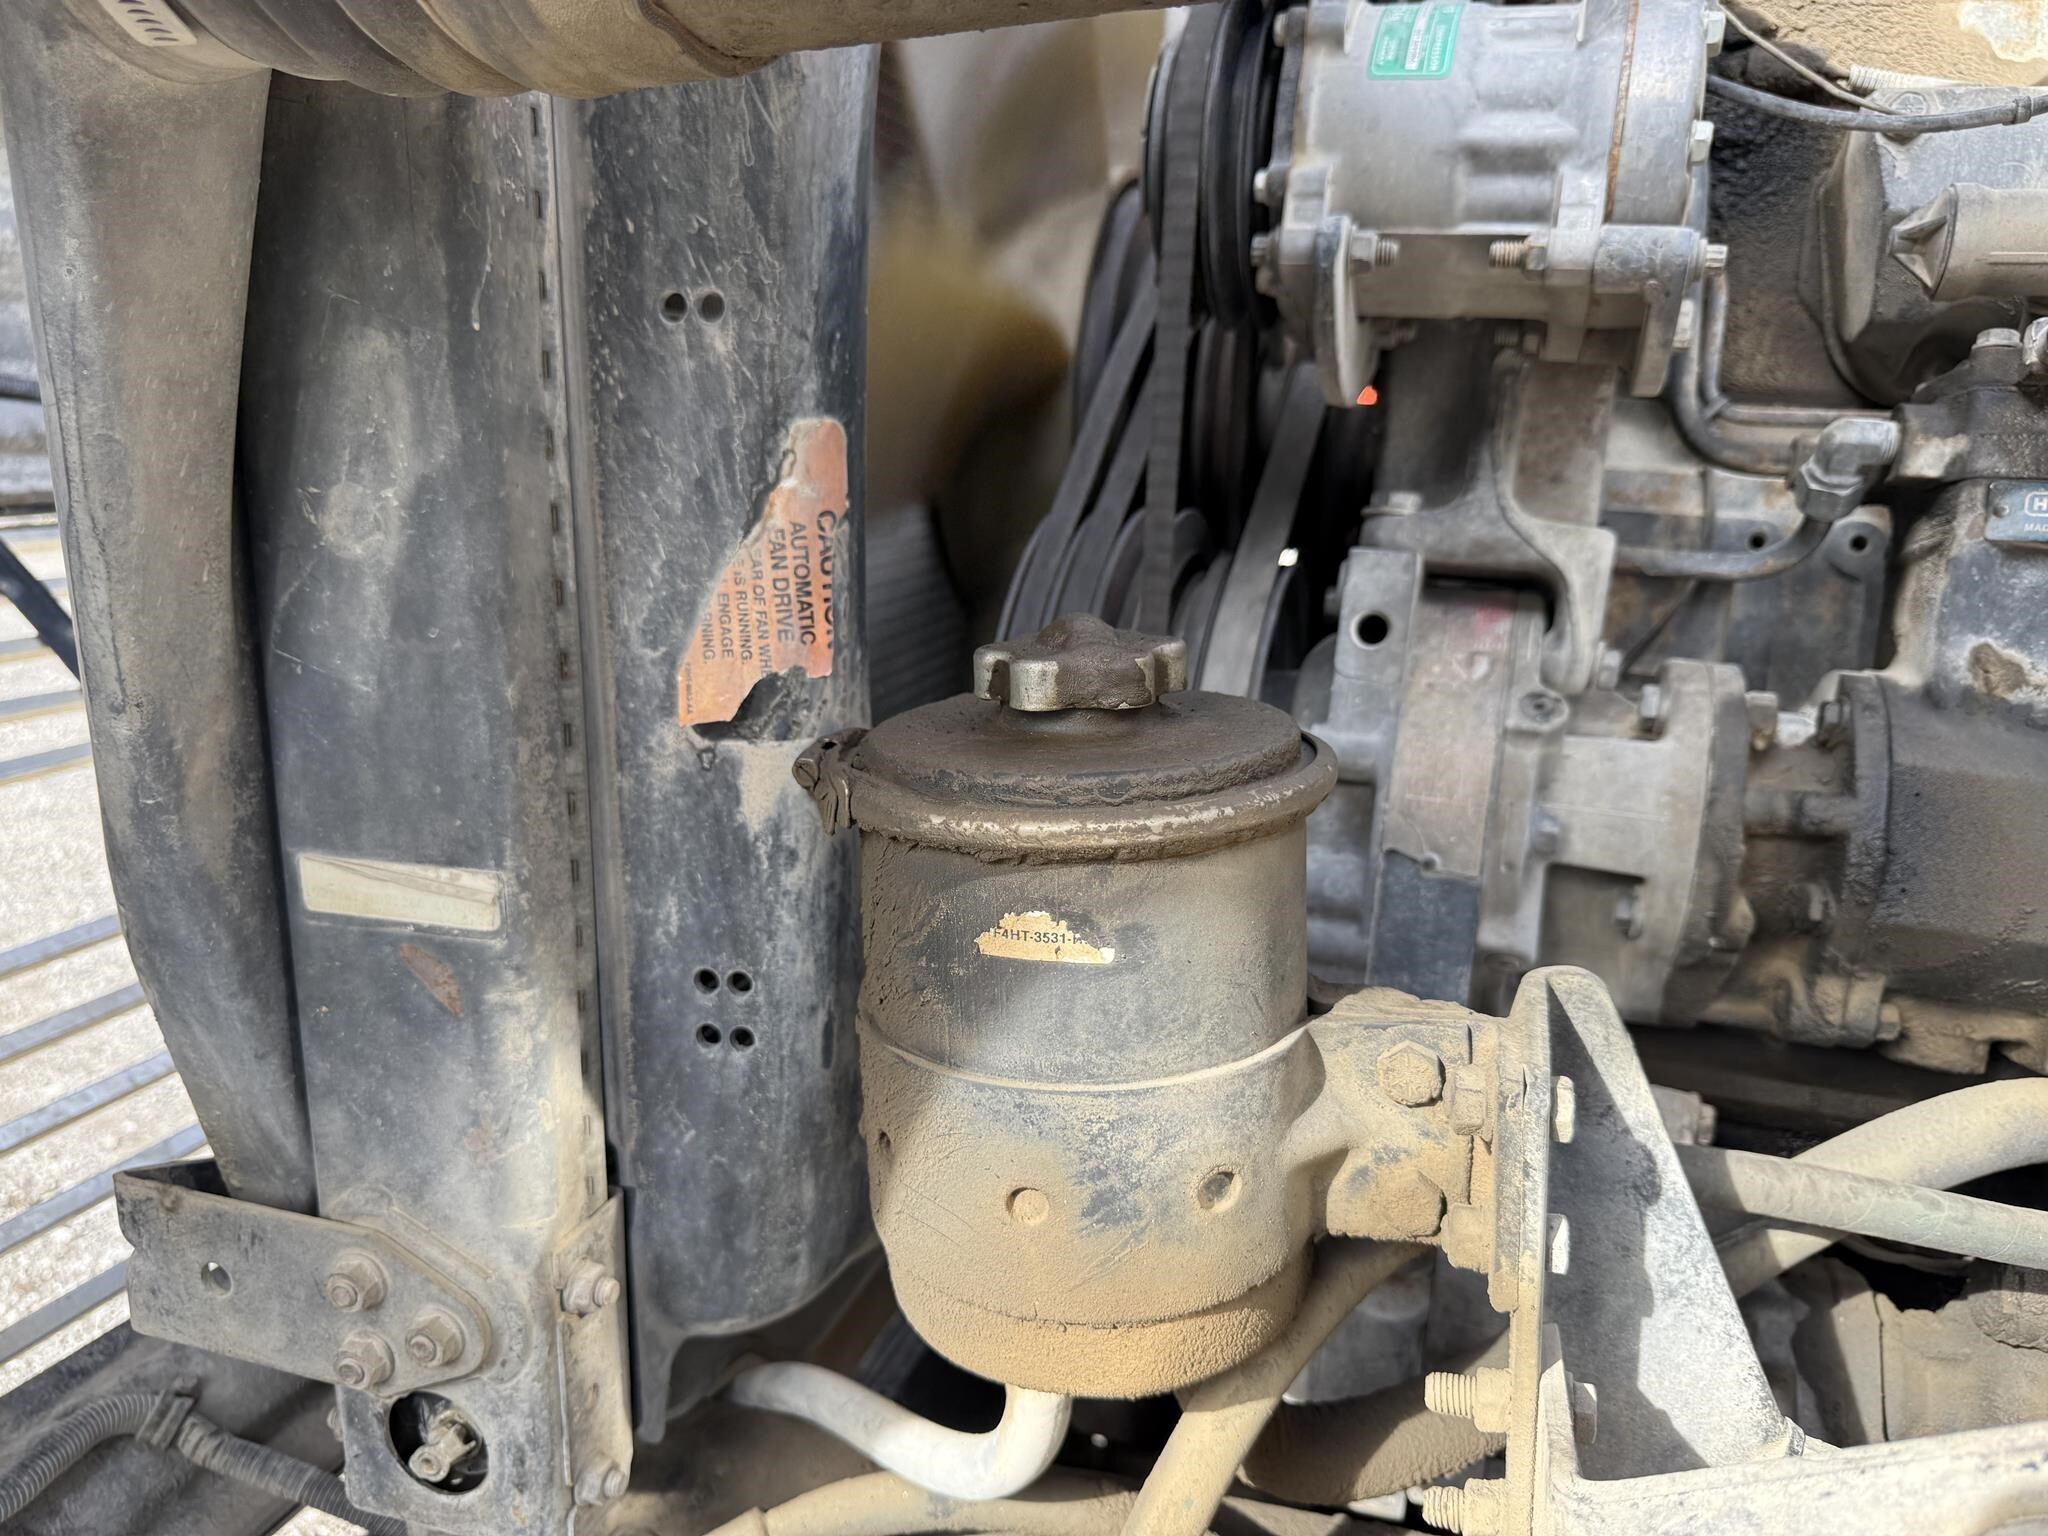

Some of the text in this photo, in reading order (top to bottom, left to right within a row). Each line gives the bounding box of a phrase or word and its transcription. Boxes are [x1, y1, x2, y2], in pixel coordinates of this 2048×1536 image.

[734, 571, 746, 585] IS
[752, 584, 766, 606] OF
[769, 527, 795, 643] FAN DRIVE
[790, 521, 817, 646] AUTOMATIC
[701, 612, 715, 665] RNING.
[718, 592, 735, 659] ENGAGE
[735, 590, 753, 665] RUNNING.
[755, 610, 770, 640] FAN
[759, 643, 773, 679] WHE
